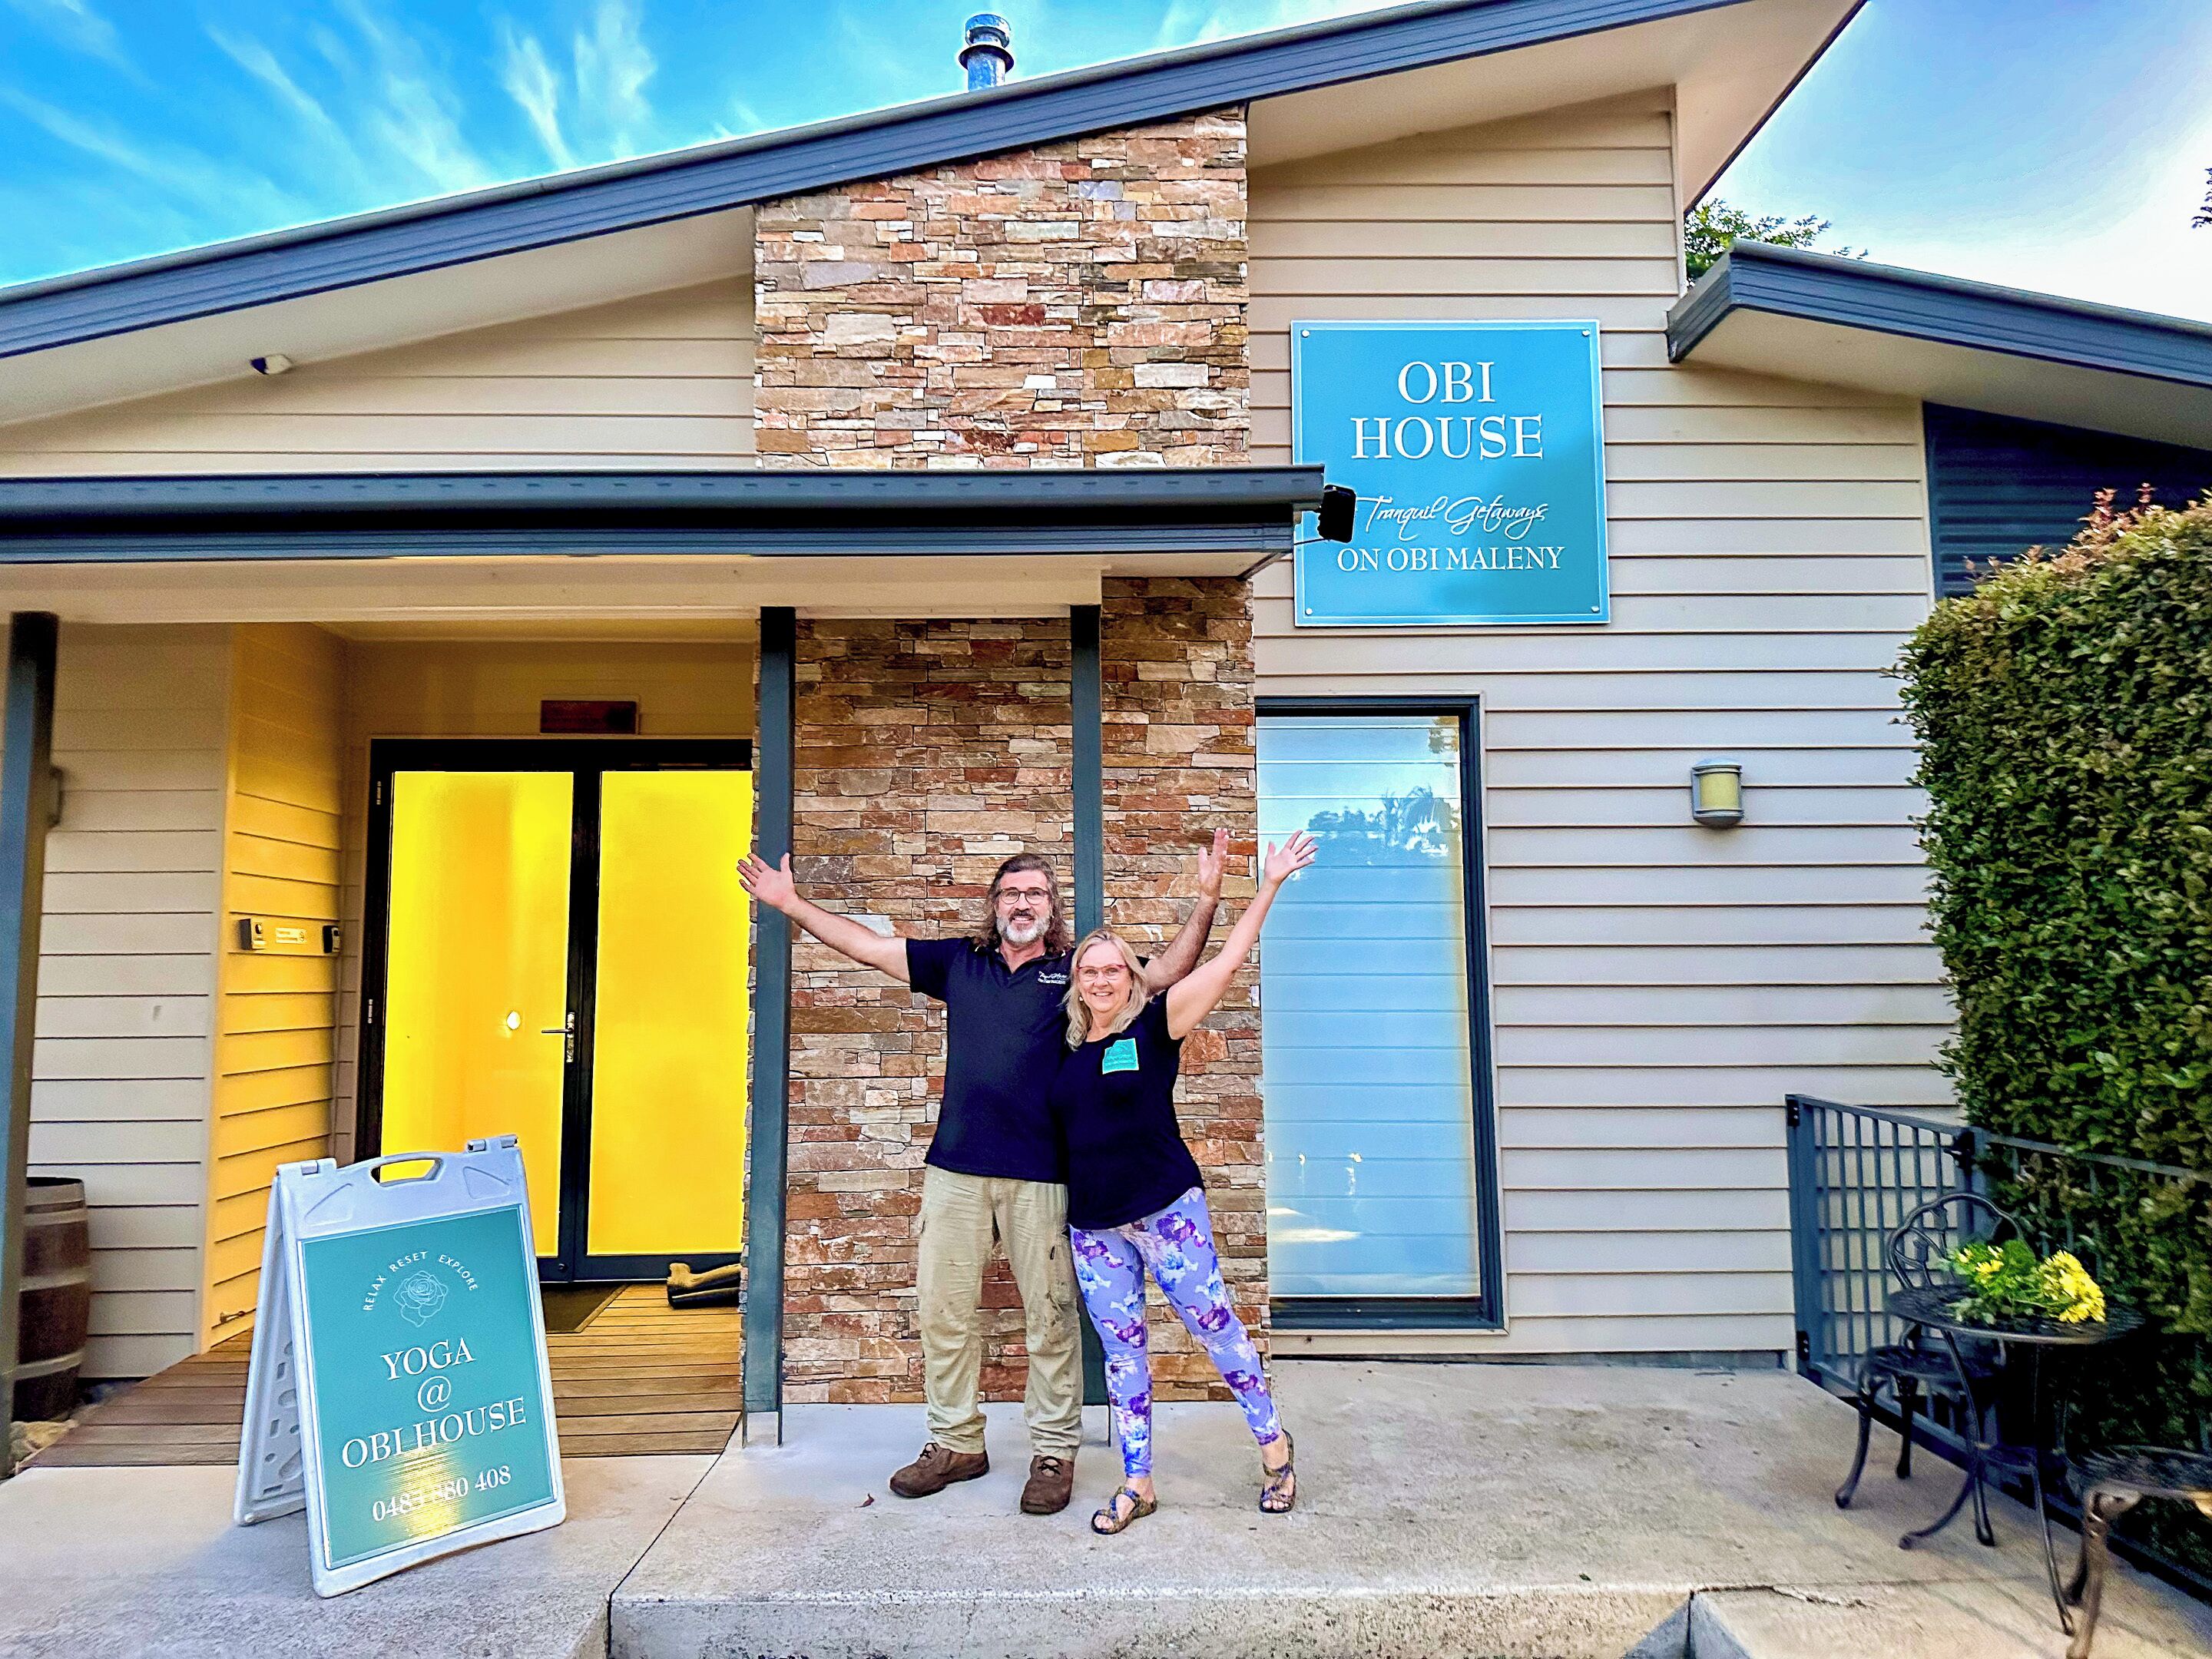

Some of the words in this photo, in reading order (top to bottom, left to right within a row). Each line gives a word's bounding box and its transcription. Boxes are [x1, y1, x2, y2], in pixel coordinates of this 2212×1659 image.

[1397, 361, 1496, 404] OBI
[1350, 413, 1544, 460] HOUSE
[1356, 495, 1449, 541] Tranquil
[1444, 495, 1548, 541] Getaways
[1337, 547, 1382, 571] ON
[1386, 546, 1439, 571] OBI
[1445, 545, 1565, 571] MALENY
[363, 1274, 387, 1312] RELAX
[389, 1250, 429, 1273] RESET
[438, 1253, 478, 1291] EXPLORE
[380, 1337, 477, 1382] YOGA
[417, 1375, 452, 1413] @
[341, 1426, 403, 1469] OBI
[412, 1397, 527, 1451] HOUSE
[474, 1464, 512, 1492] 408
